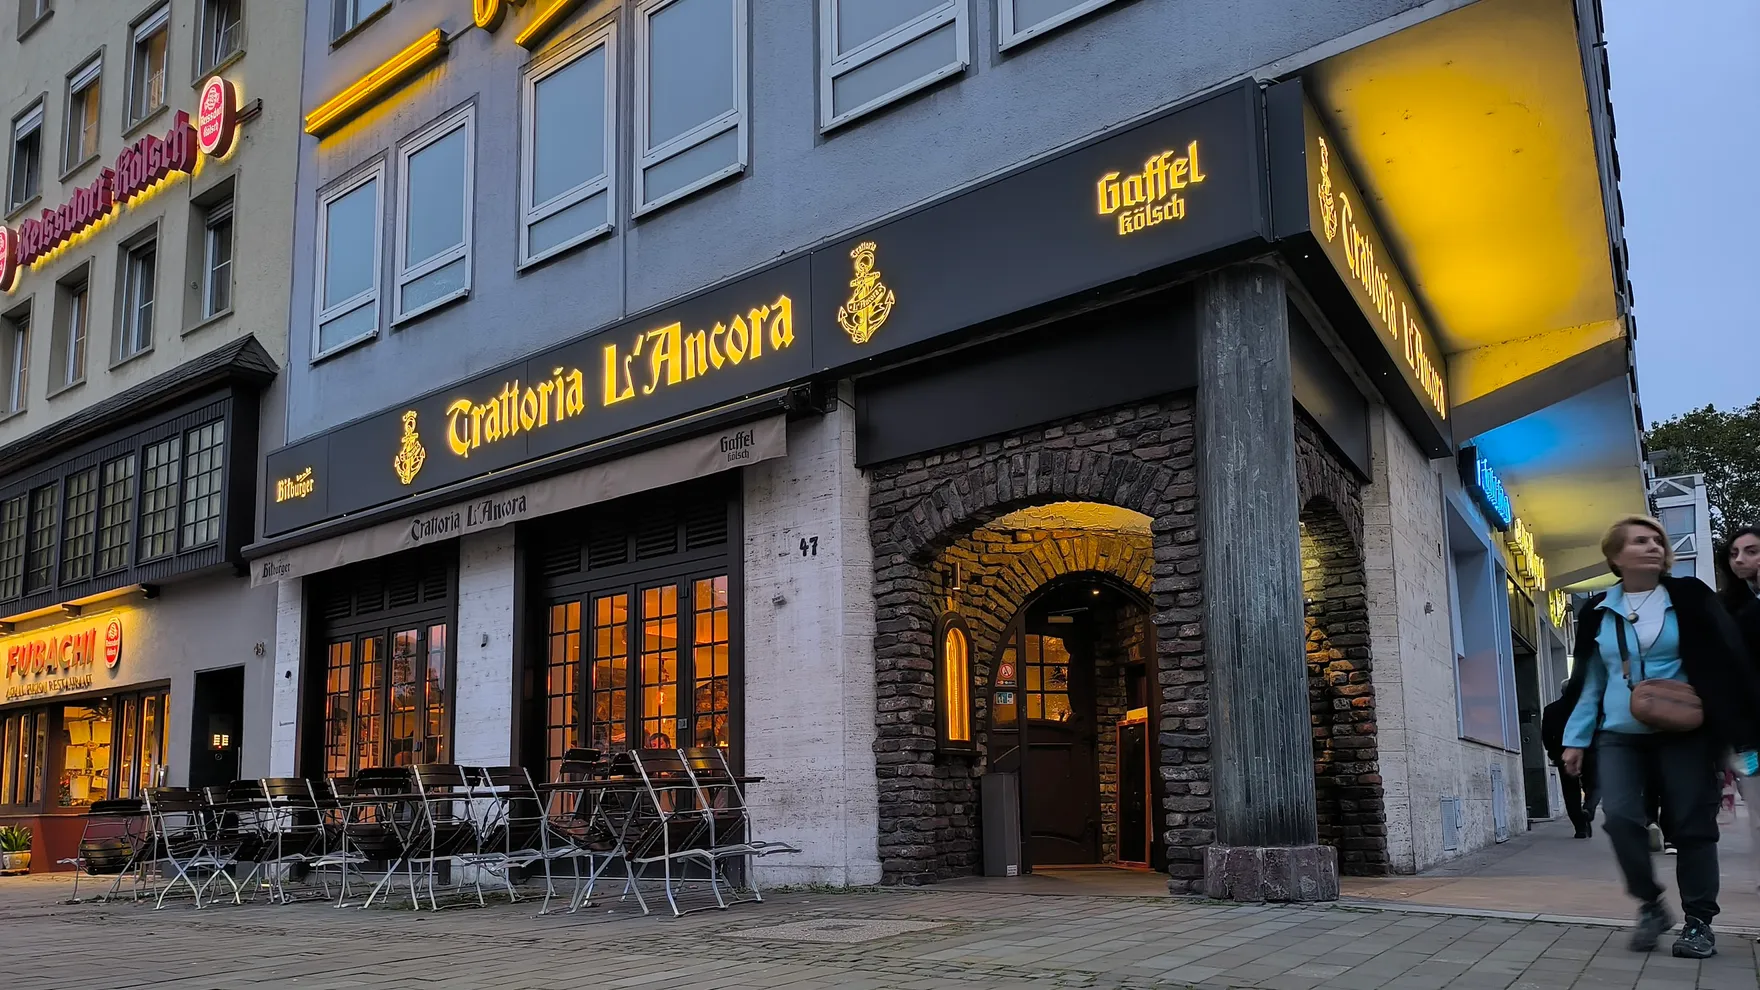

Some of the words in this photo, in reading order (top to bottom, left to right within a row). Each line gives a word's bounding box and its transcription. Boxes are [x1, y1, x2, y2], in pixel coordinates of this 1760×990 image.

[16, 168, 113, 264] Reissdorf
[112, 111, 195, 202] Kölsch
[1098, 140, 1206, 214] Gaffel
[1340, 192, 1398, 340] Trattoria
[1402, 302, 1446, 420] L'Ancora
[446, 366, 585, 458] Trattoria
[603, 294, 796, 408] L'Ancora
[720, 430, 755, 452] Gaffel
[276, 478, 314, 502] Bitburger
[411, 511, 460, 541] Trattoria
[466, 495, 527, 527] L'Ancora
[262, 561, 290, 578] Bitburger
[800, 536, 818, 557] 47
[5, 627, 96, 679] FUBACHI
